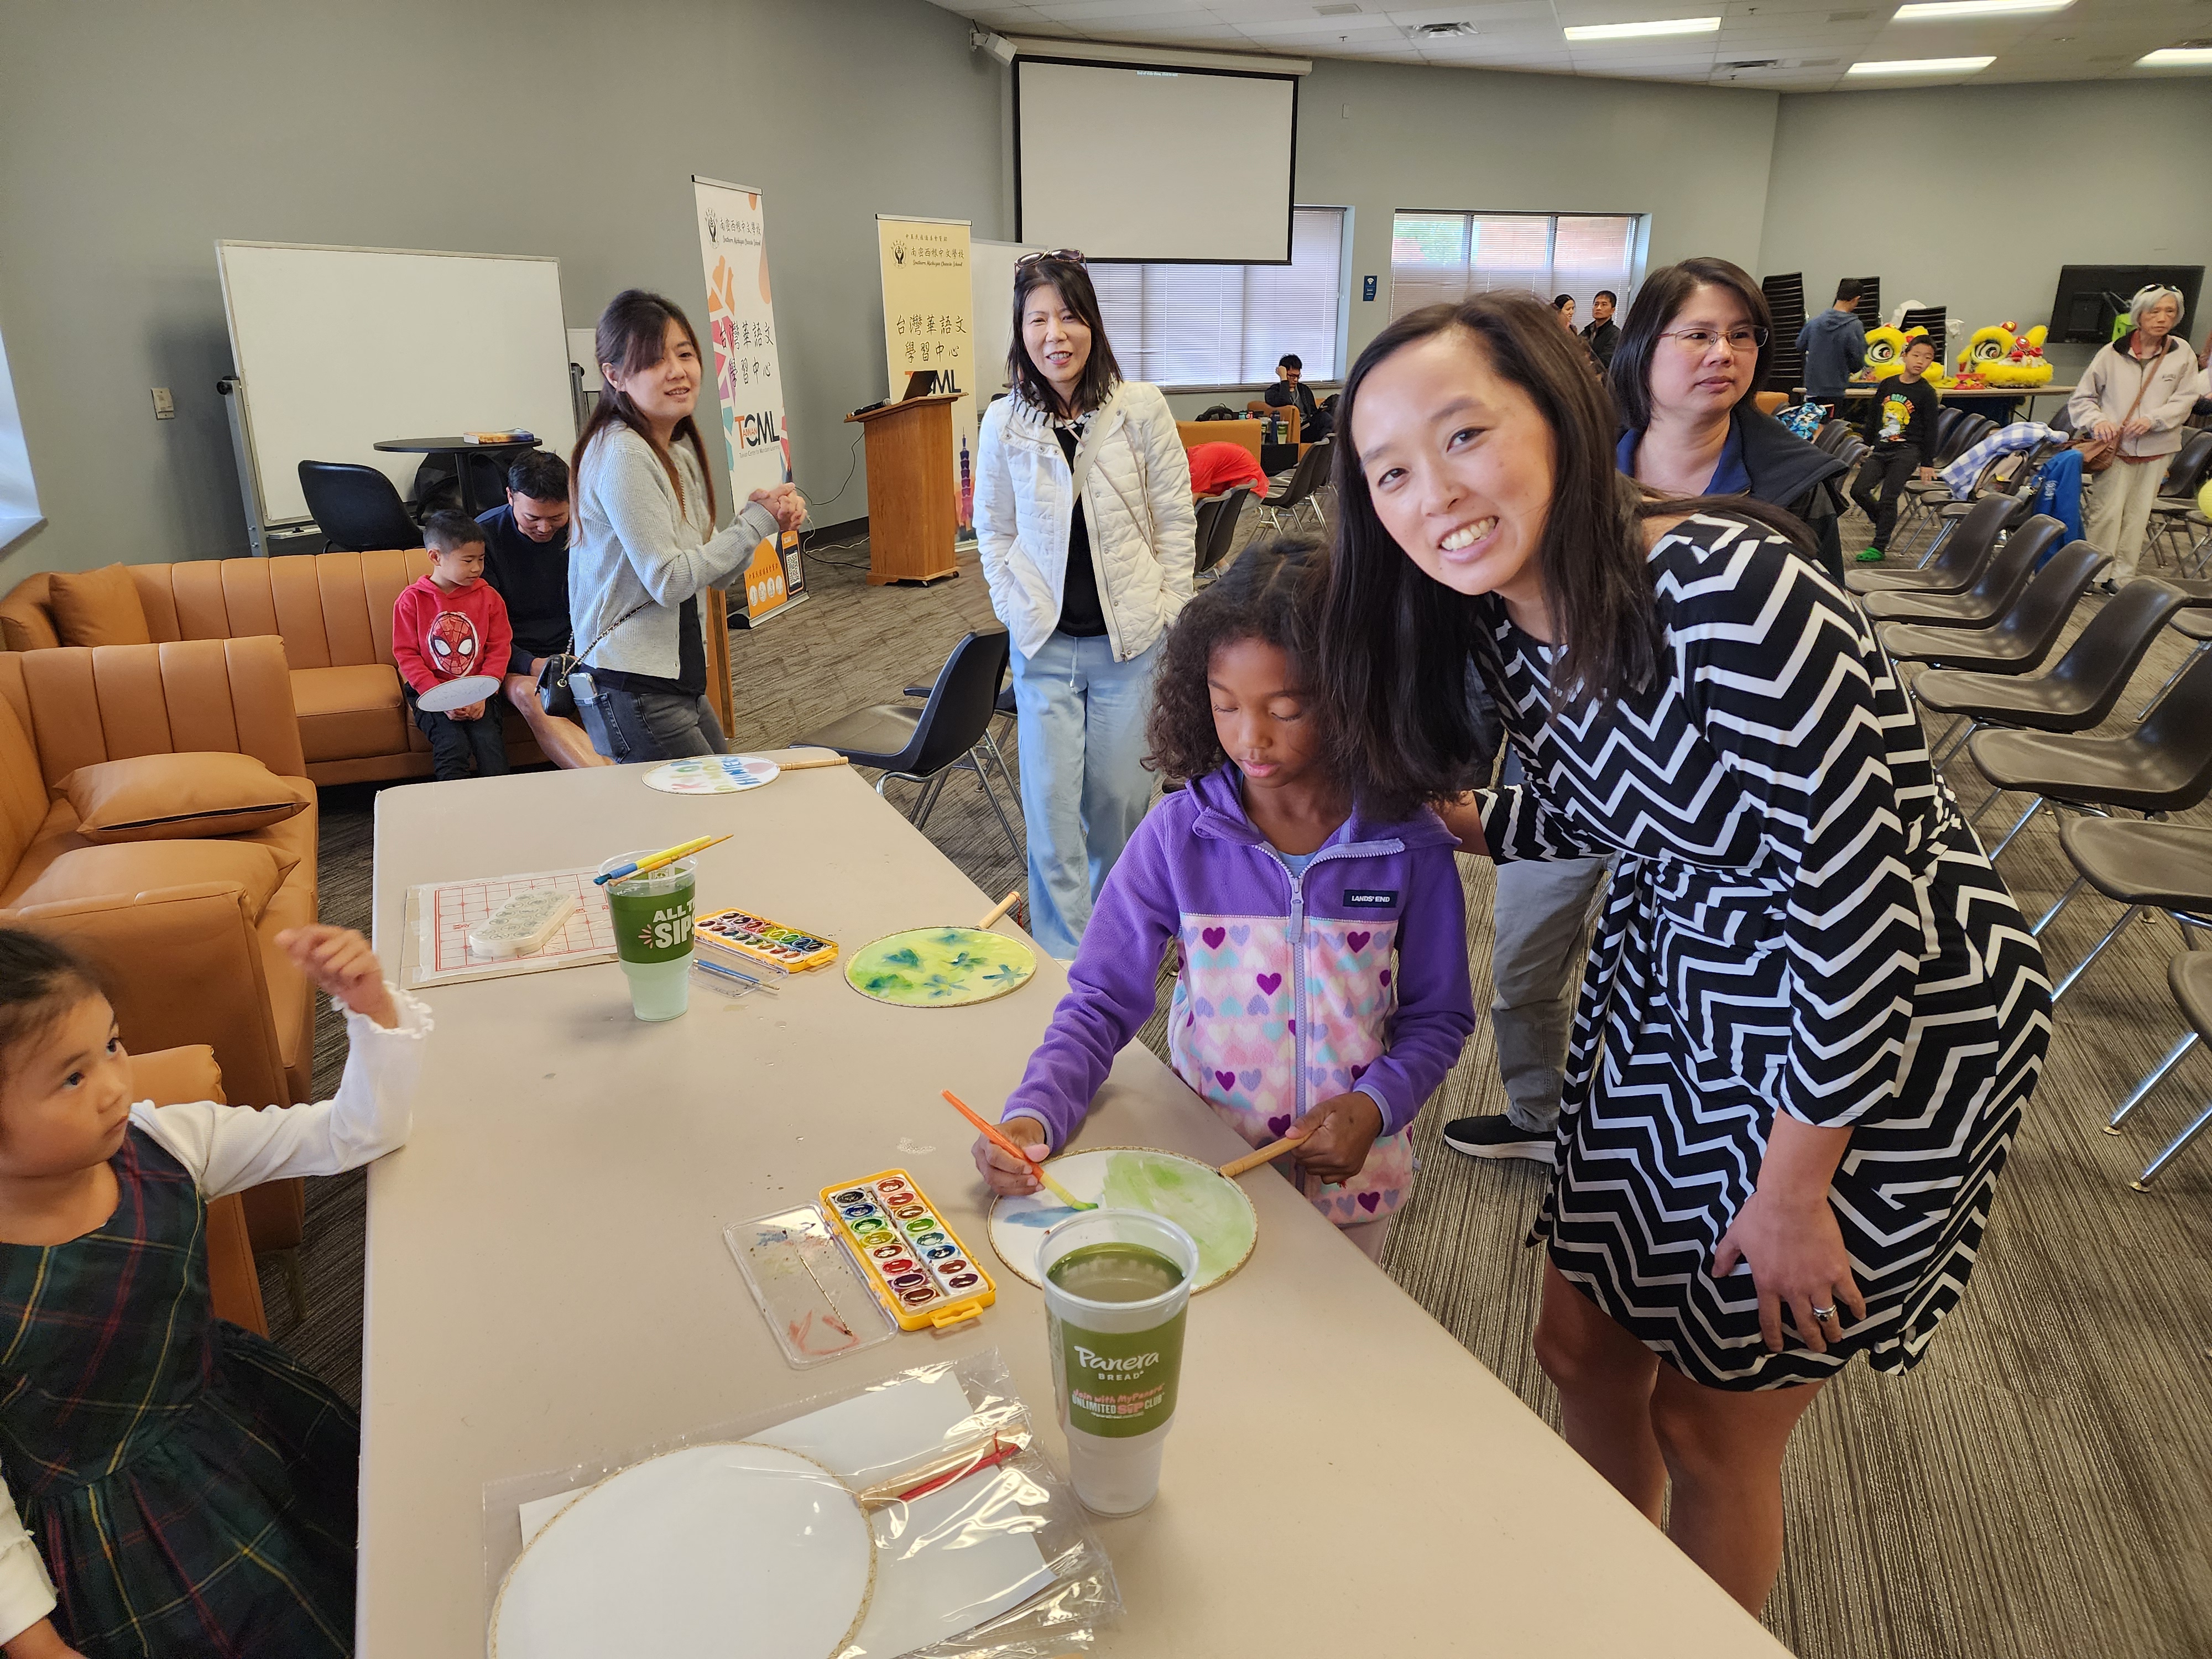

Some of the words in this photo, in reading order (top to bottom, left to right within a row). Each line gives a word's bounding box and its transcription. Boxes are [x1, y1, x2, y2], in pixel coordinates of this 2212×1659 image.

[719, 320, 774, 349] 台灣華語文
[896, 314, 967, 336] 台灣華語文
[905, 341, 959, 363] 學習中心
[728, 357, 771, 387] 學習中心
[734, 410, 780, 449] TCML
[653, 905, 686, 923] ALL
[1073, 1345, 1160, 1371] Panera
[1072, 1394, 1116, 1415] UNLIMITED
[1073, 1389, 1092, 1401] Join
[1094, 1395, 1116, 1404] with
